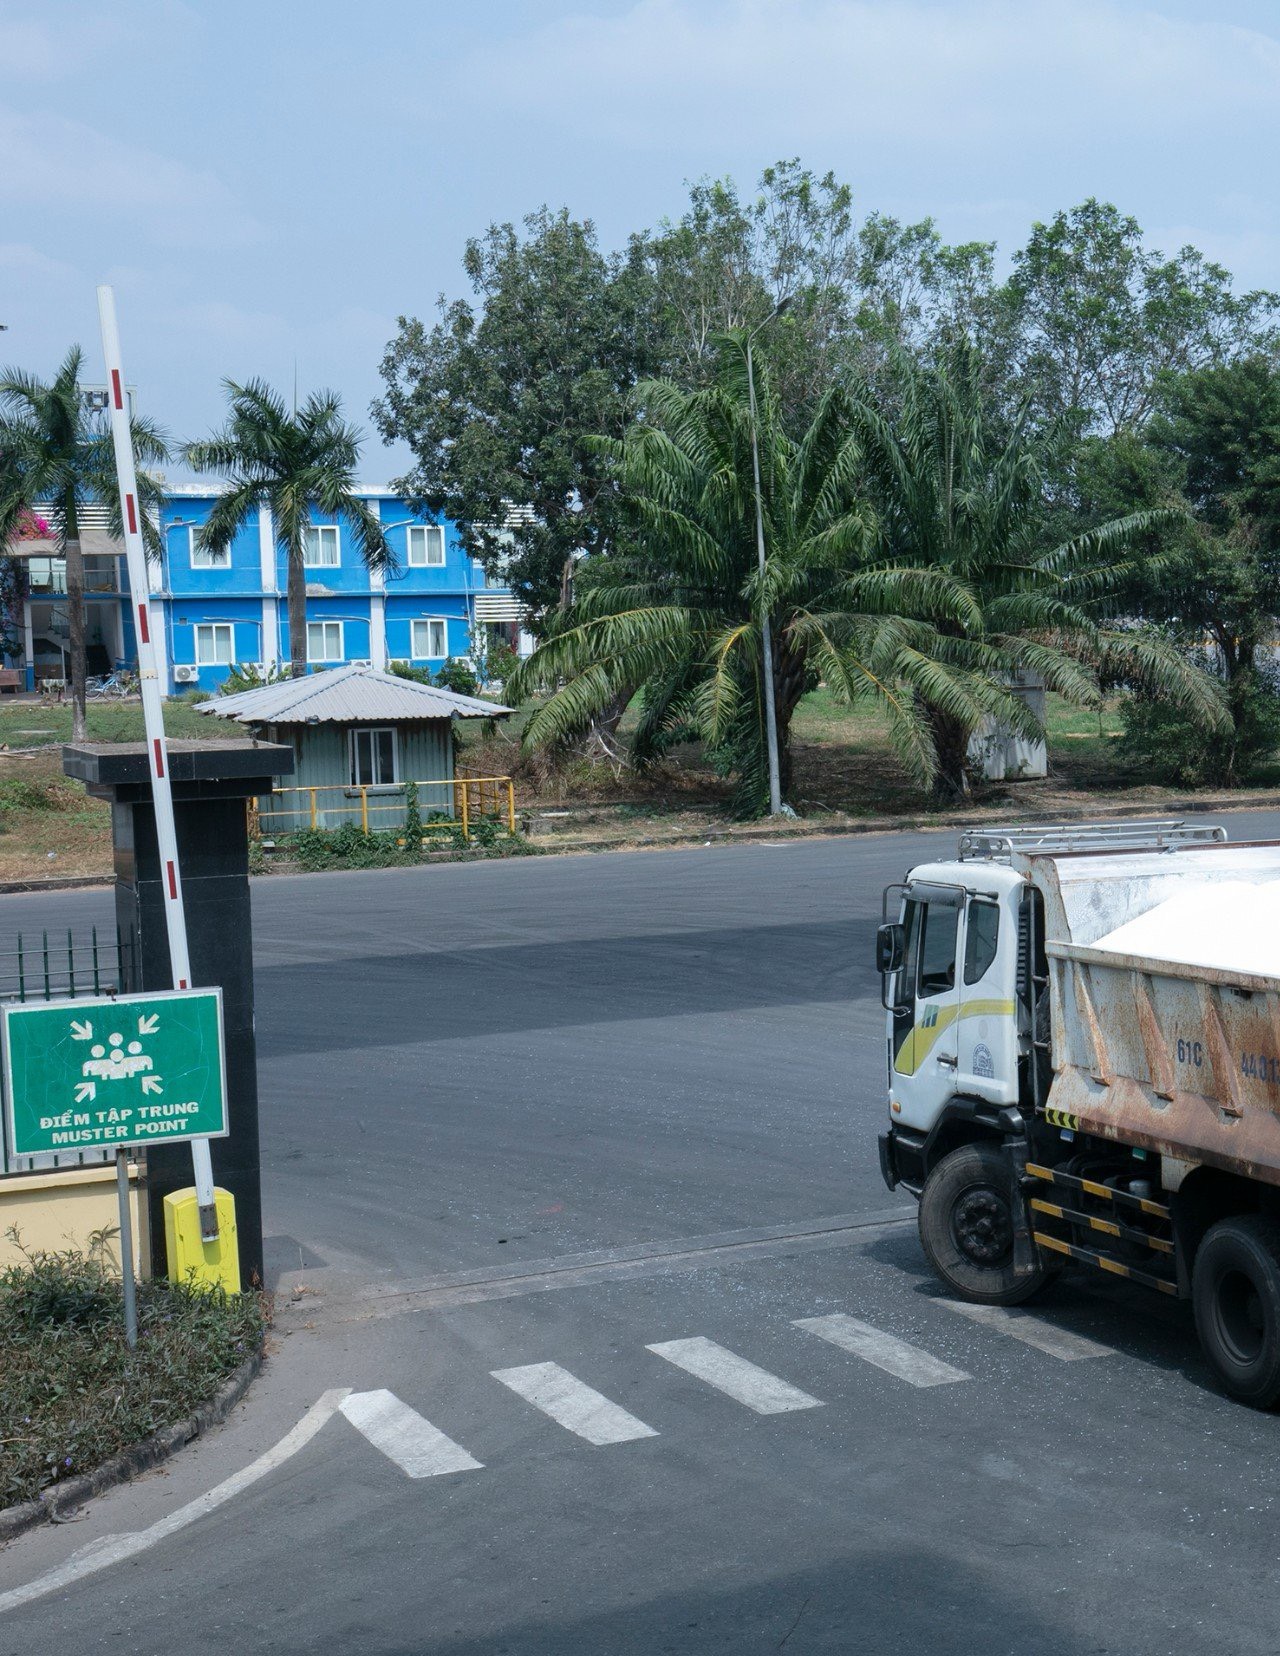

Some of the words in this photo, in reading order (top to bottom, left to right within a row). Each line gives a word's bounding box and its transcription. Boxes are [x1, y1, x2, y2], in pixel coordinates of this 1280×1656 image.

[1177, 1038, 1203, 1068] 61C
[39, 1109, 91, 1129] ĐIỂM
[95, 1107, 133, 1124] TẬP
[137, 1101, 199, 1119] TRUNG
[52, 1125, 128, 1144] MUSTER
[134, 1118, 189, 1135] POINT
